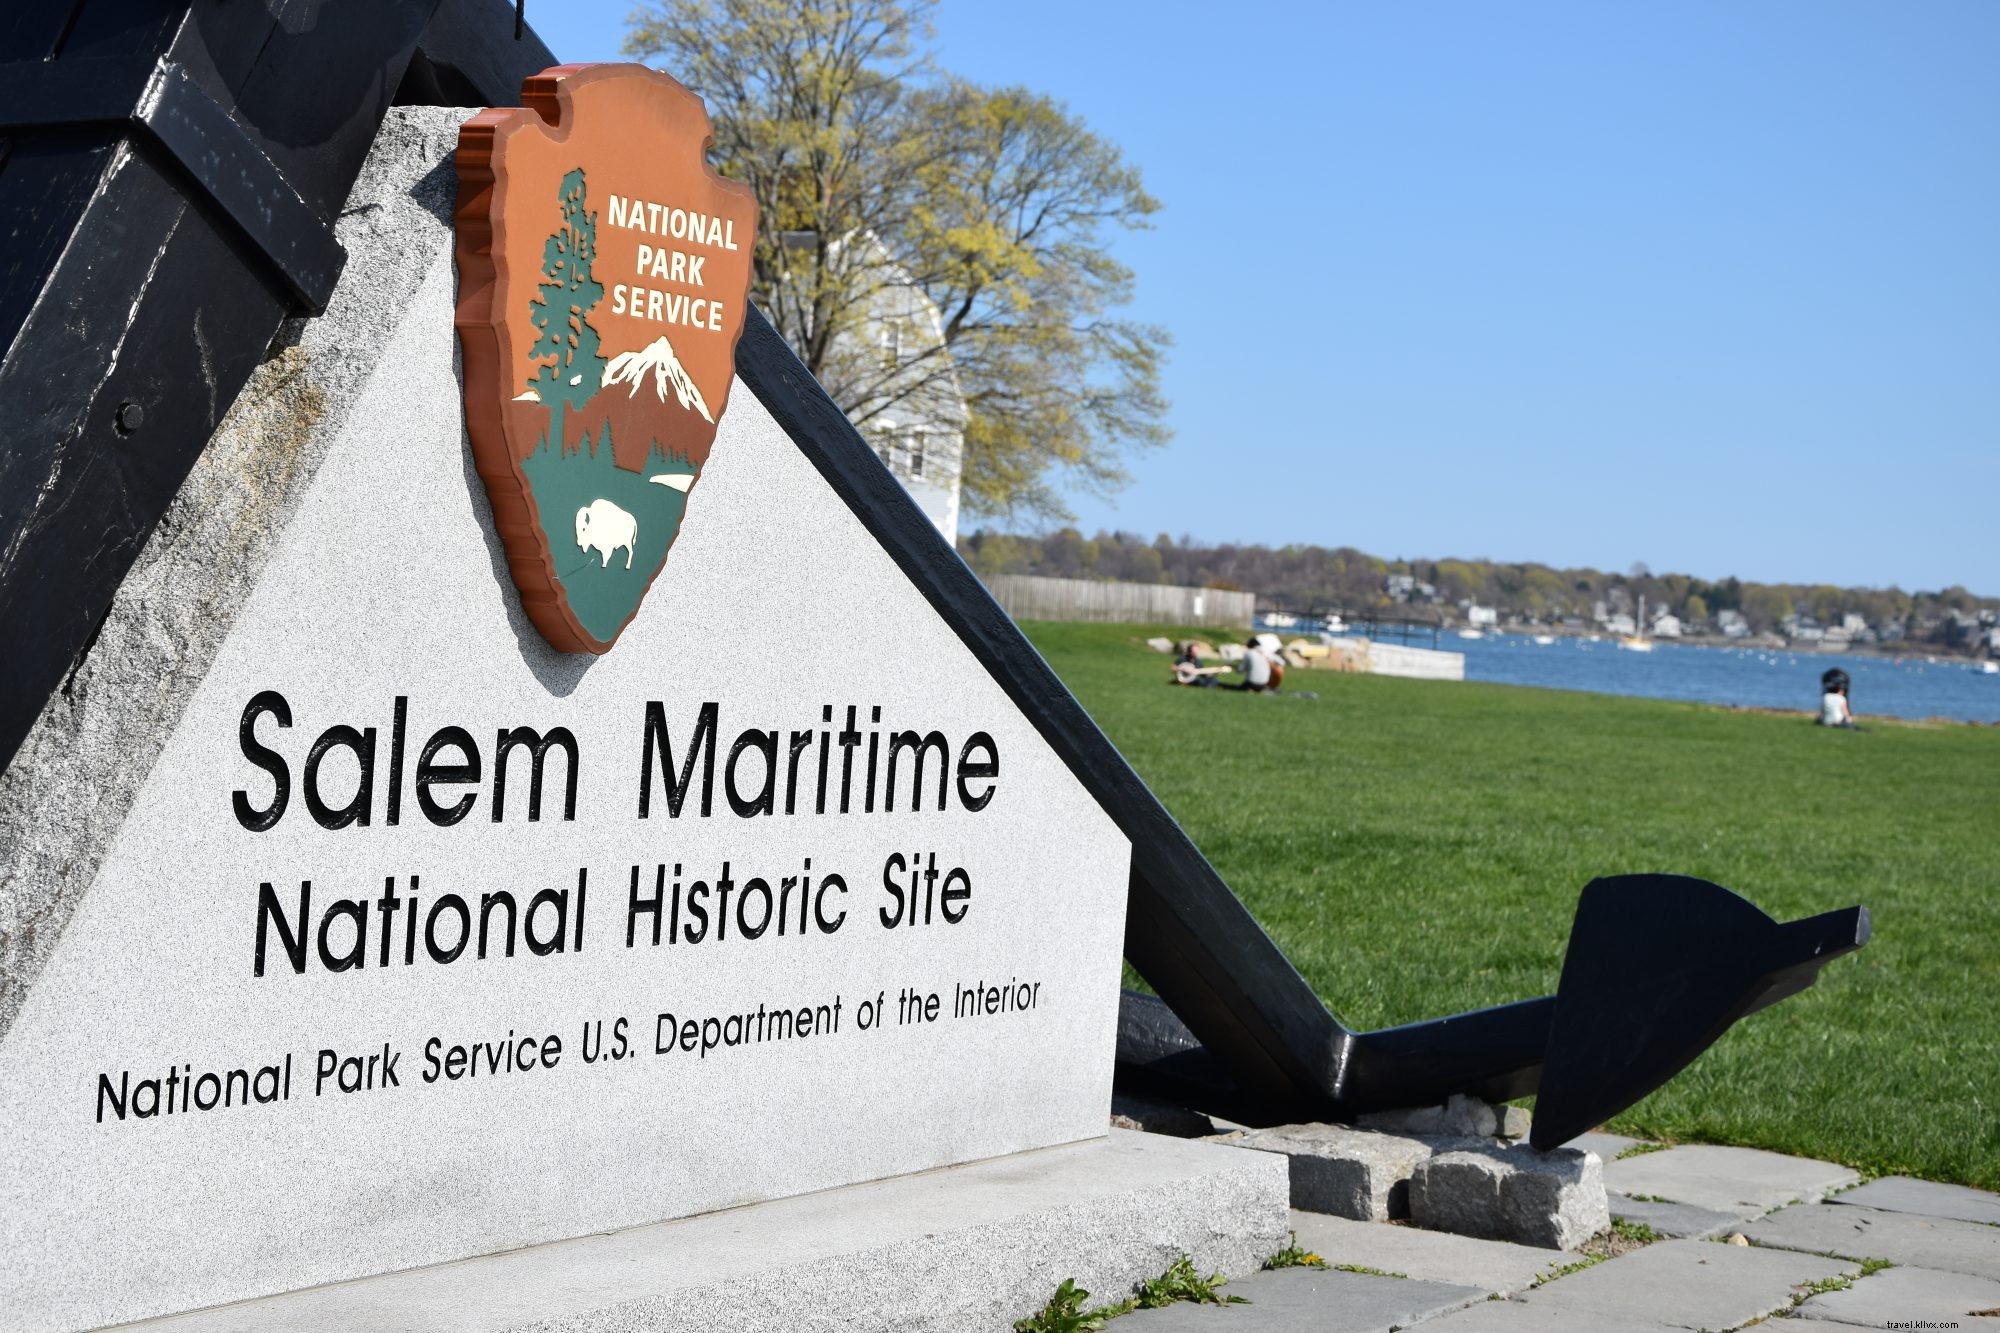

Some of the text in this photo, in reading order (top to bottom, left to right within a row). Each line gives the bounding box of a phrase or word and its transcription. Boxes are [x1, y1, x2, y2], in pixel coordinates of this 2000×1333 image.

[608, 195, 738, 251] NATIONAL
[637, 245, 706, 286] PARK
[612, 284, 723, 331] SERVICE
[232, 690, 1000, 832] Salem Maritime
[254, 852, 972, 977] National Historic Site
[97, 977, 1041, 1123] National Park Service U.S. Department of the Interior
